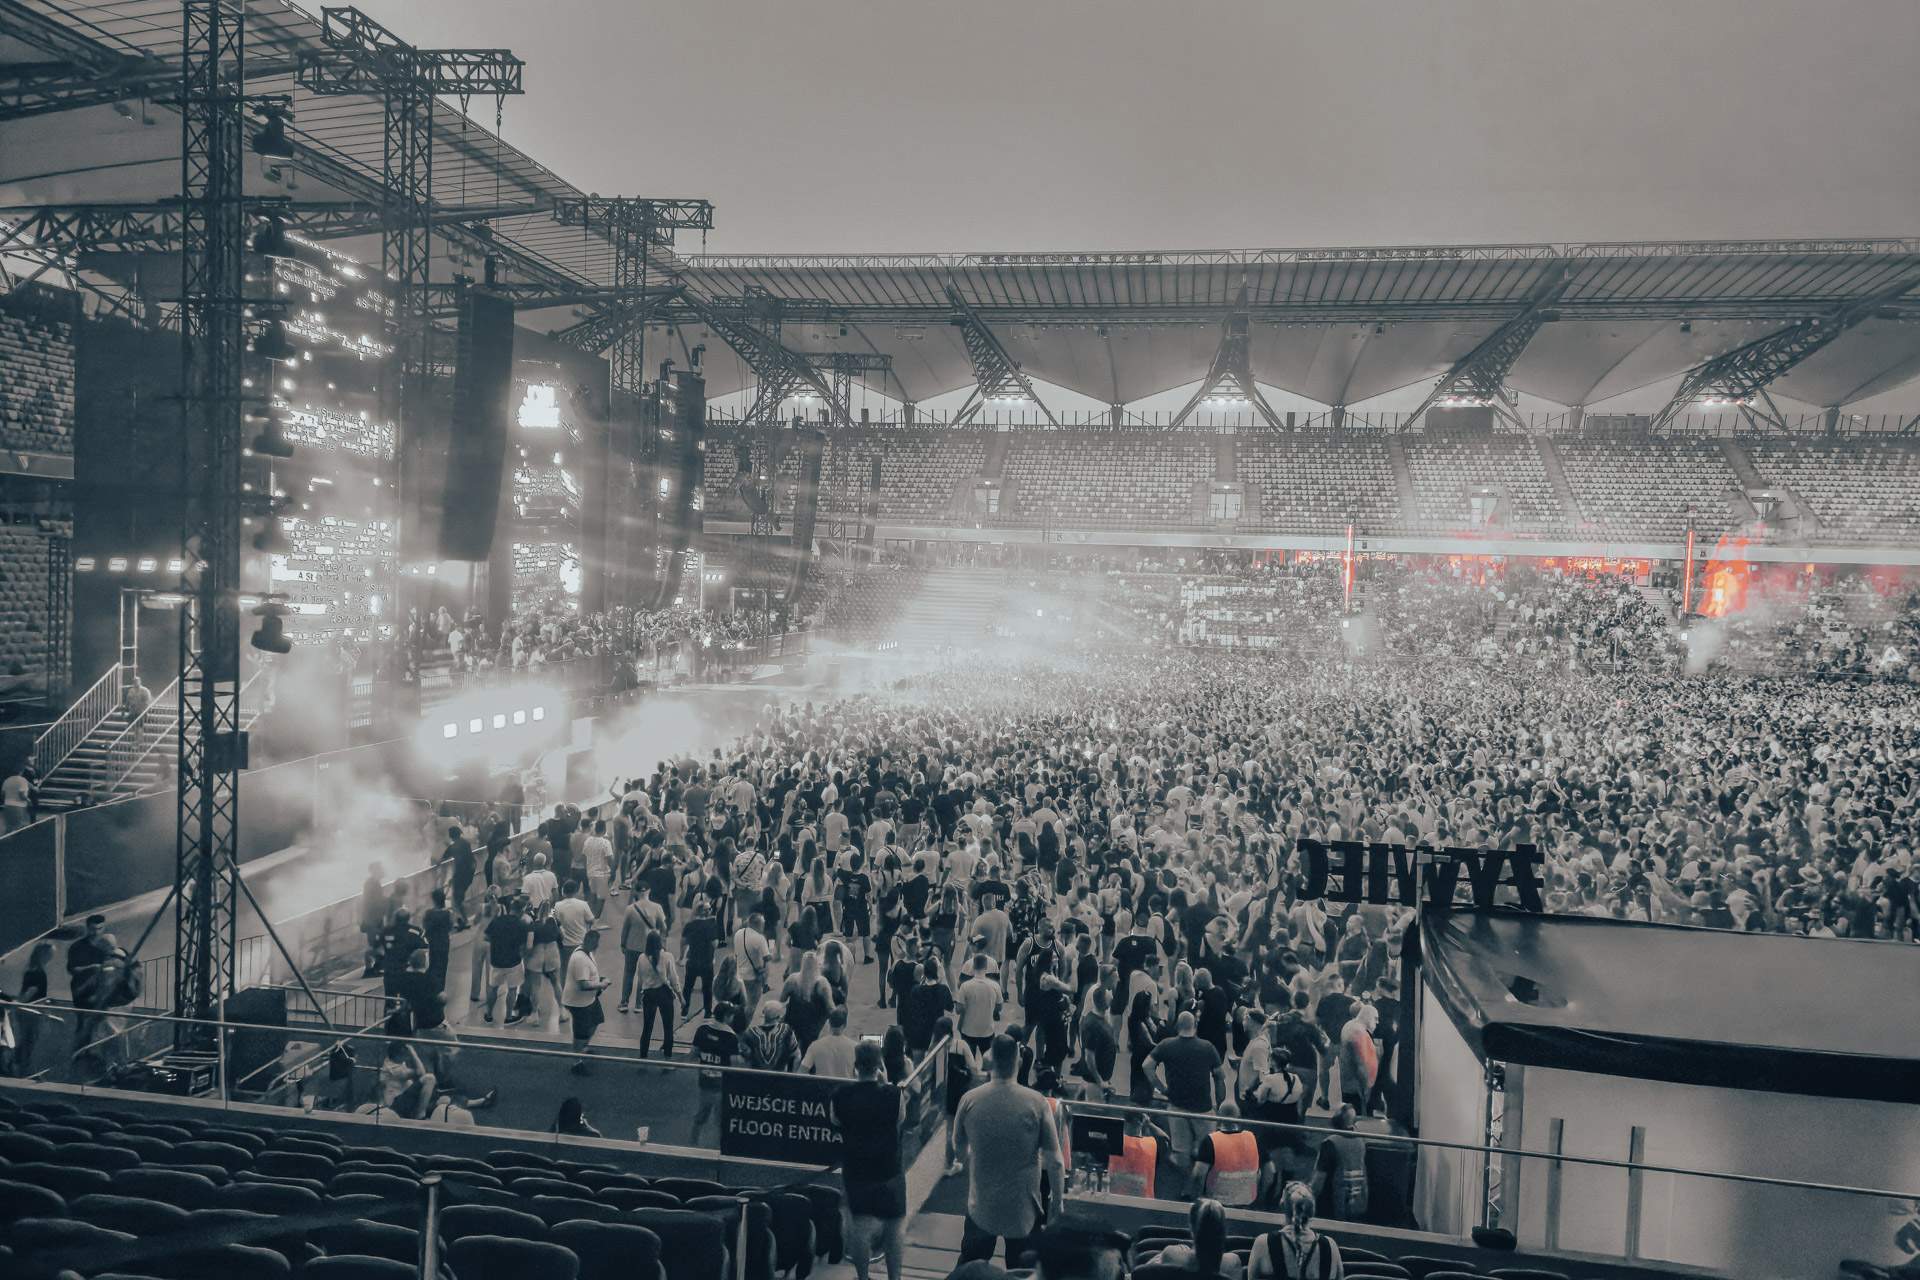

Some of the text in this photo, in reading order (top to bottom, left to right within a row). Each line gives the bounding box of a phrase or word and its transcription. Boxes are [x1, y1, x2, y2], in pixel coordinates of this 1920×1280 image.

[728, 1093, 826, 1118] WEJŚCIE NA
[729, 1118, 844, 1144] FLOOR ENTRA
